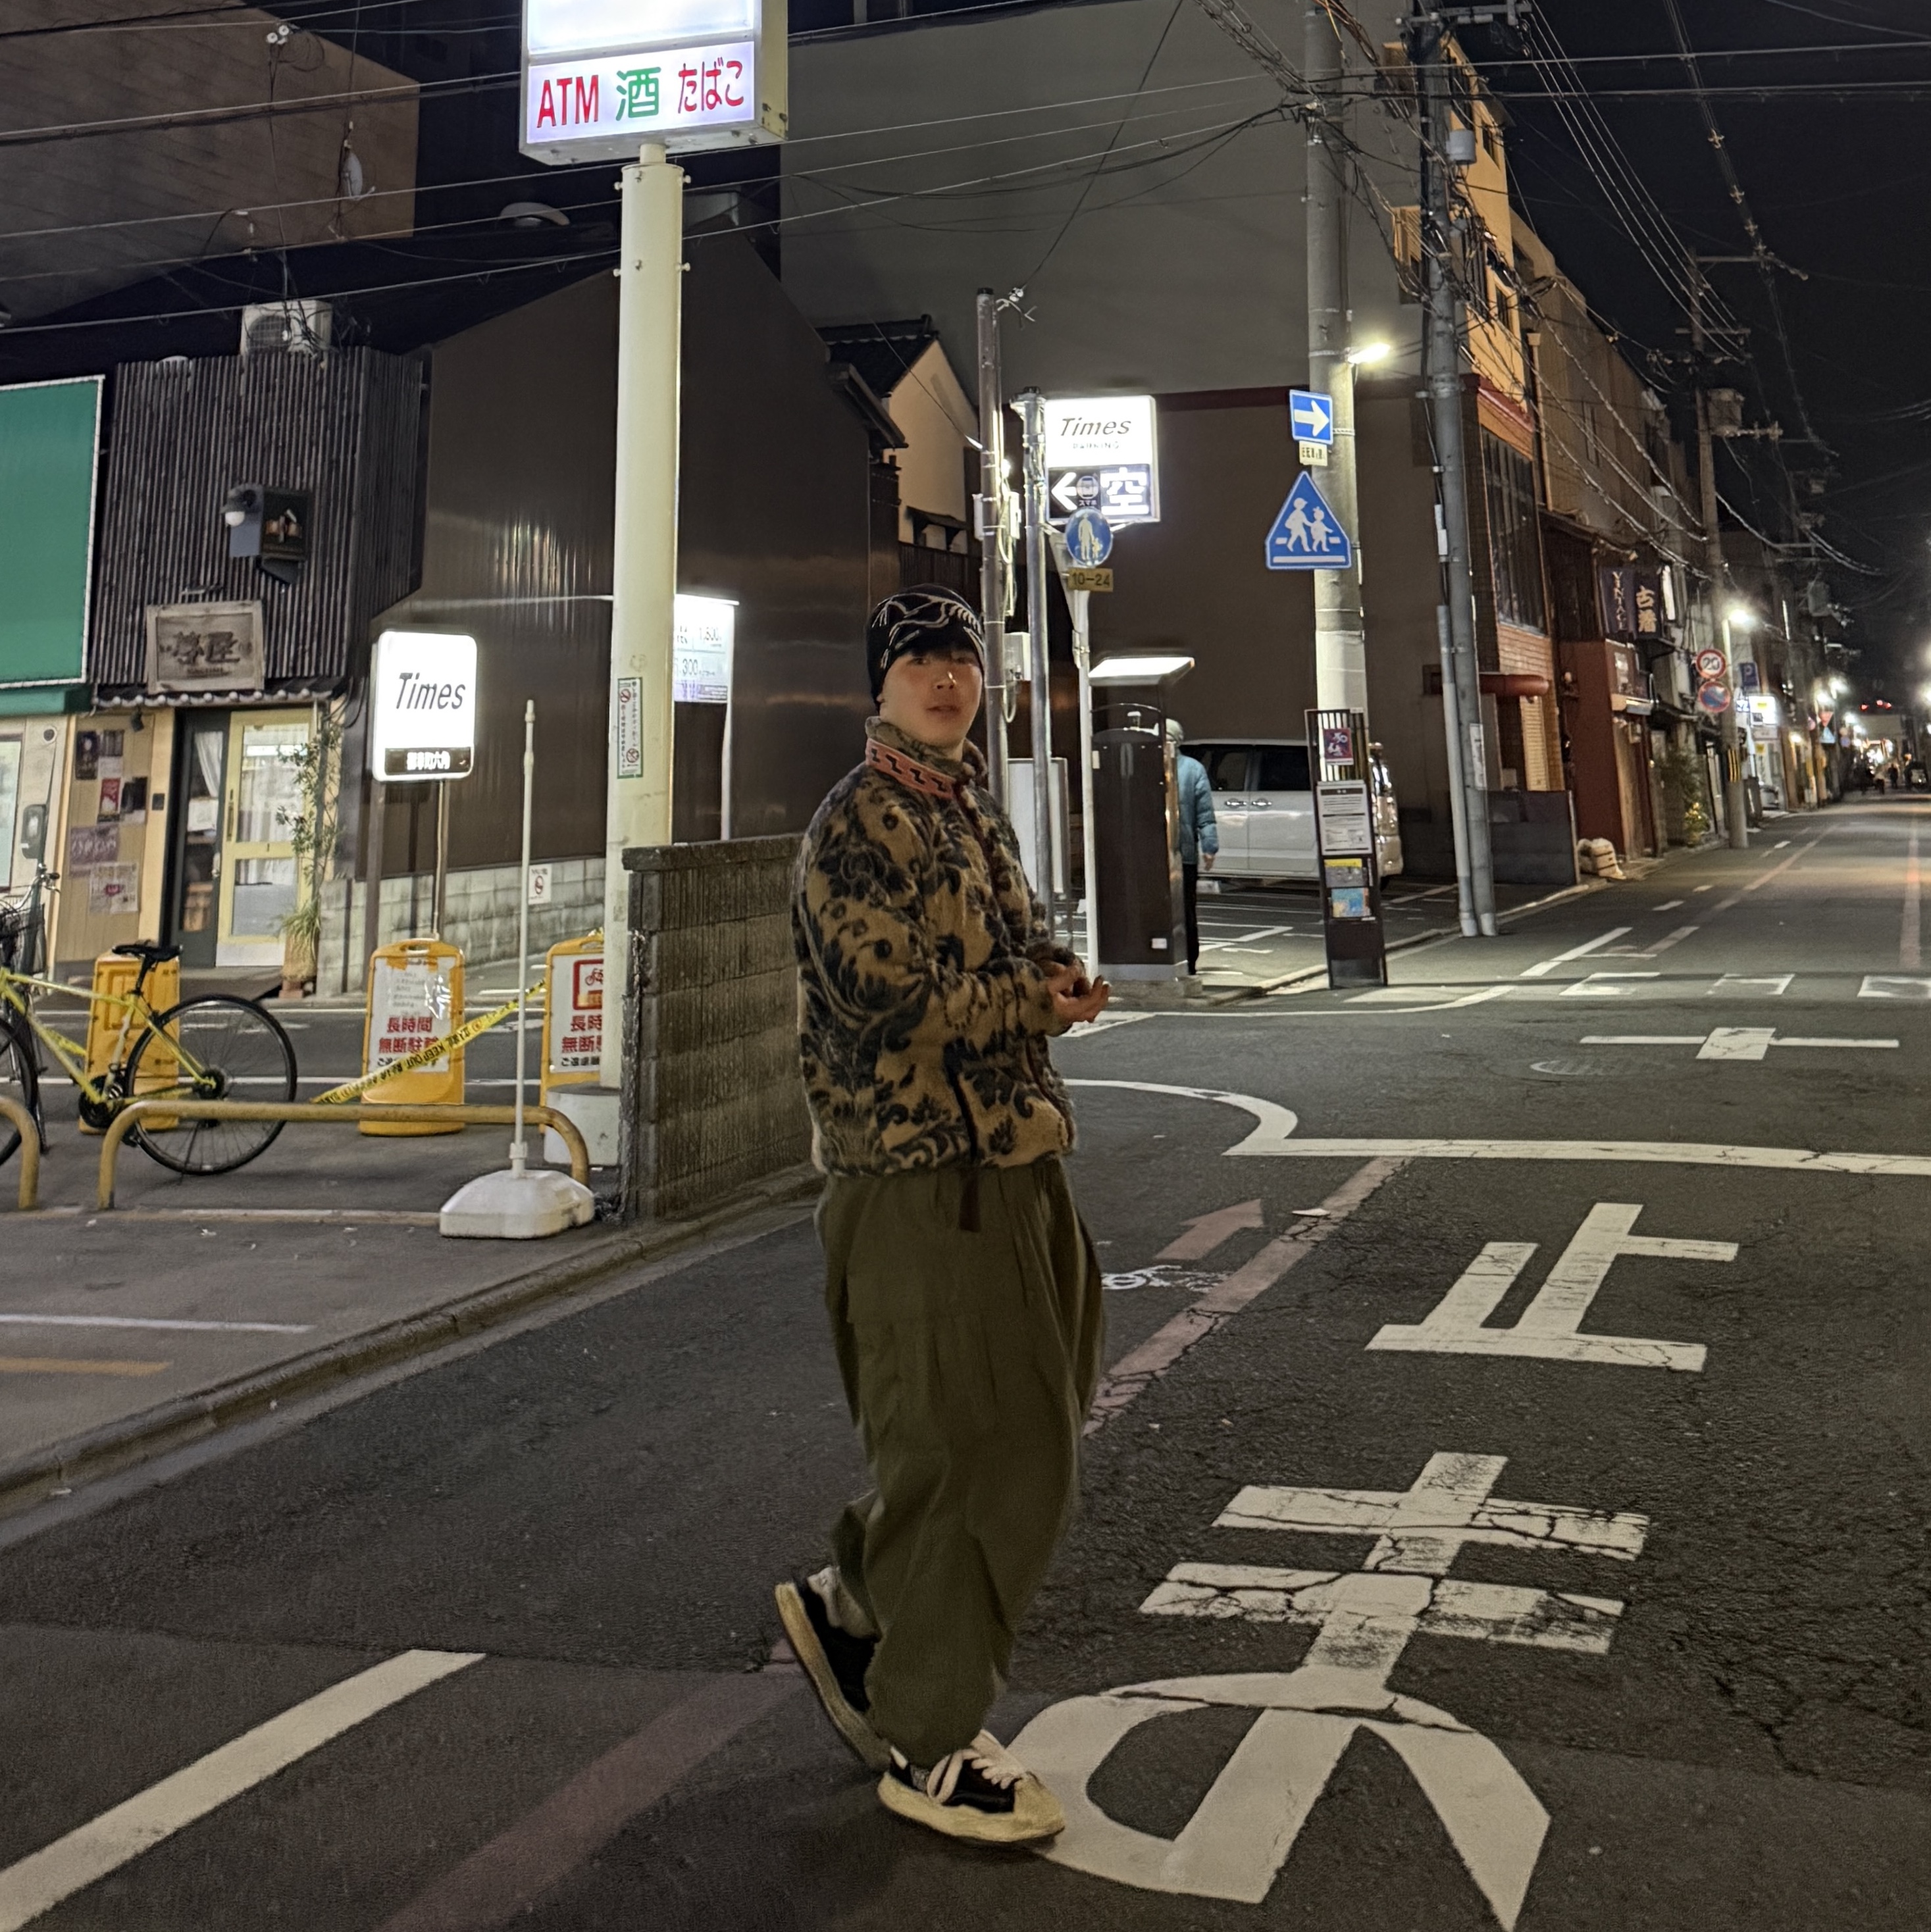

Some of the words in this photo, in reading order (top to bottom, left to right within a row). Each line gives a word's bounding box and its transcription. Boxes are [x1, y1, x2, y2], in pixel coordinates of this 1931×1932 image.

[536, 74, 600, 128] ATM
[615, 66, 661, 121] 酒
[678, 57, 744, 113] たばこ
[1060, 417, 1132, 436] Times
[1100, 467, 1149, 515] 空
[1071, 572, 1111, 586] 10-24
[1702, 657, 1720, 671] 20
[396, 673, 466, 710] Times
[386, 1017, 433, 1033] 長時間
[423, 1041, 447, 1062] KEEP
[406, 1054, 423, 1069] OUT
